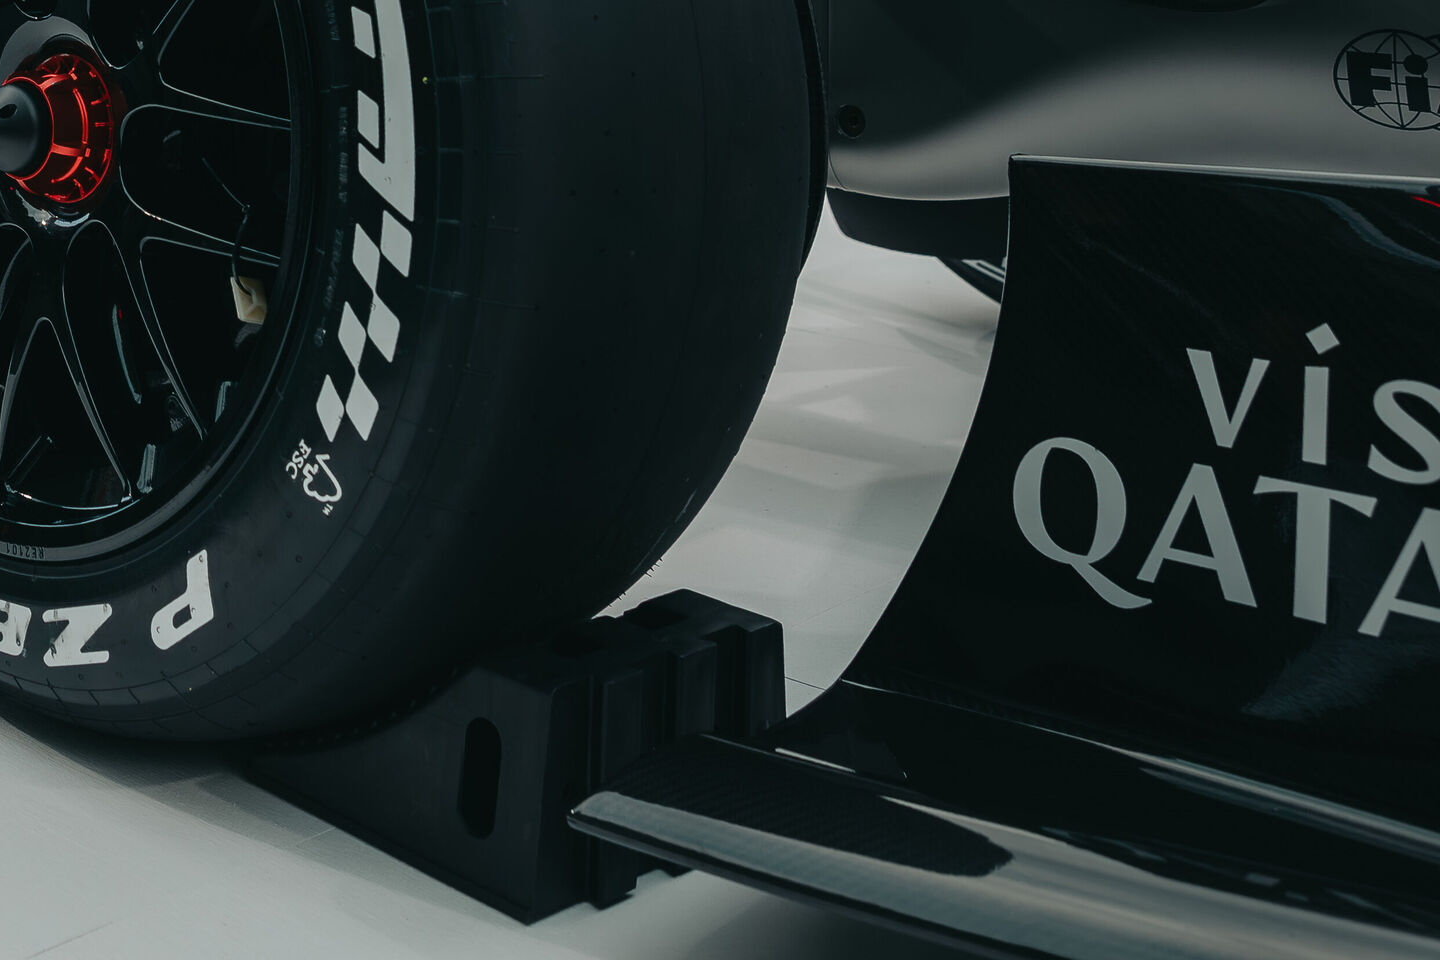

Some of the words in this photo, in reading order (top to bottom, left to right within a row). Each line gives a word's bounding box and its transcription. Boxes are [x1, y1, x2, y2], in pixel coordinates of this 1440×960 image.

[1346, 50, 1440, 113] Fi
[286, 439, 311, 480] FSC
[150, 549, 215, 650] P
